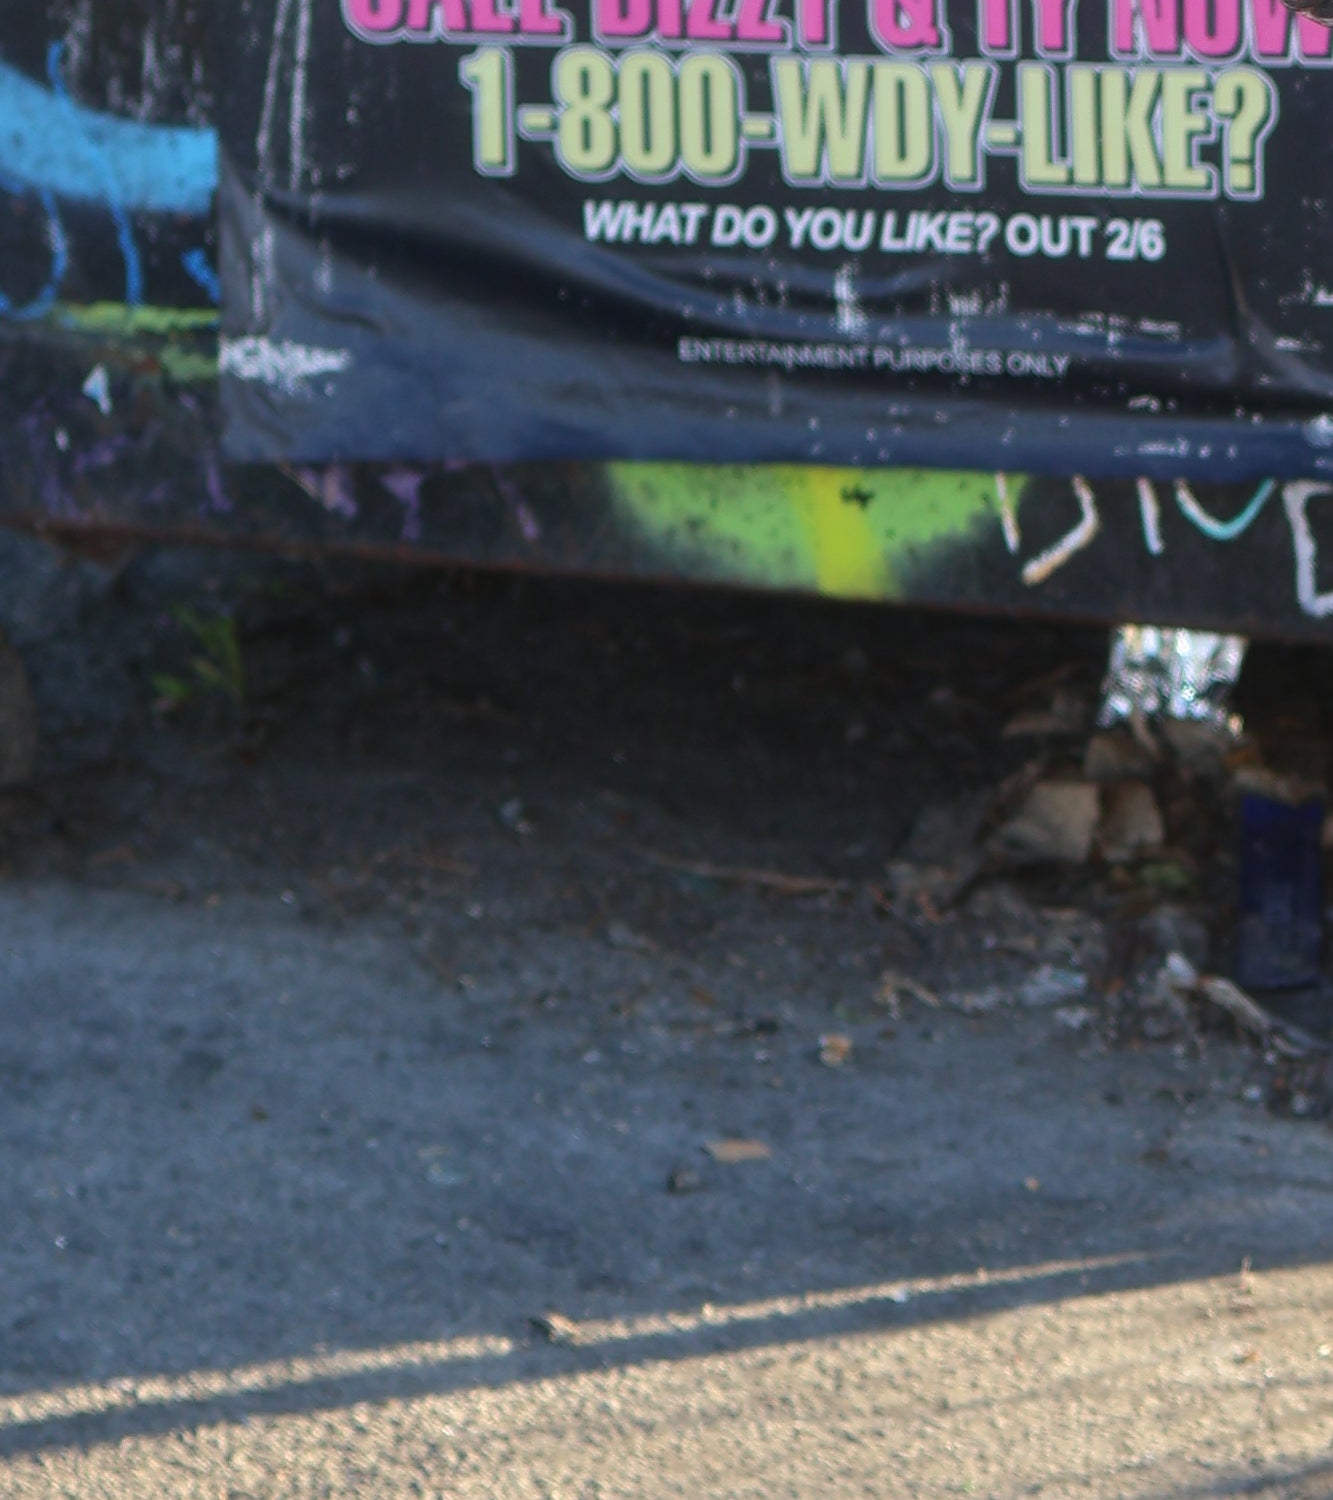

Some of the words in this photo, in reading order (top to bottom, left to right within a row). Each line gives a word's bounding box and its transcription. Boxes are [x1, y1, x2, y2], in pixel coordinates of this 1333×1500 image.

[458, 42, 1280, 200] 1-800-WDY-LIKE?
[584, 200, 705, 247] WHAT
[711, 204, 778, 248] DO
[784, 207, 879, 253] YOU
[880, 209, 1001, 257] LIKE?
[1005, 214, 1098, 259] OUT
[1106, 218, 1168, 262] 2/6
[677, 334, 873, 374] ENTERTAINMENT
[876, 348, 1004, 376] PURPOSES
[1004, 350, 1072, 378] ONLY
